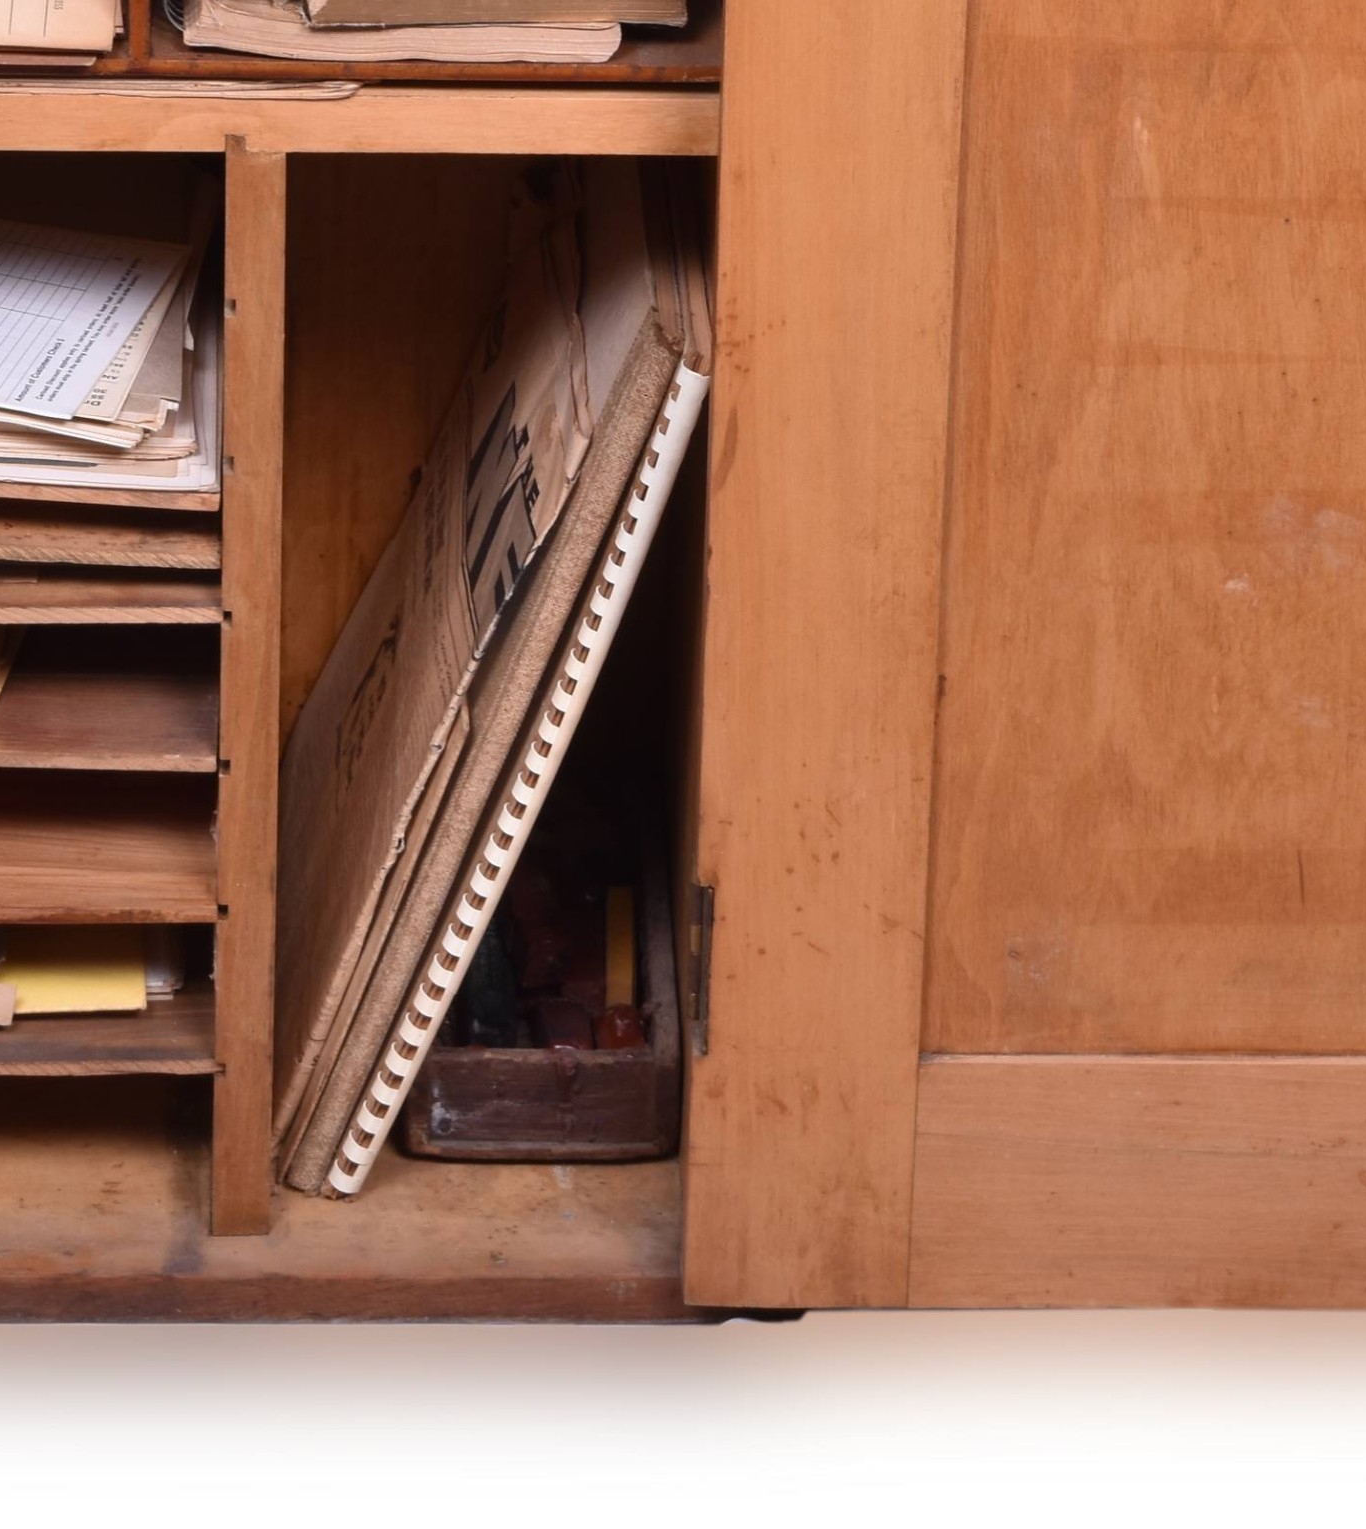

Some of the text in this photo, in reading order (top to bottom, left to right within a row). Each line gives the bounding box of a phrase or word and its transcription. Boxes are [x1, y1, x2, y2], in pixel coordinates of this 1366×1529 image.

[15, 383, 31, 401] Amount
[31, 356, 51, 377] Customers
[47, 341, 62, 355] Check
